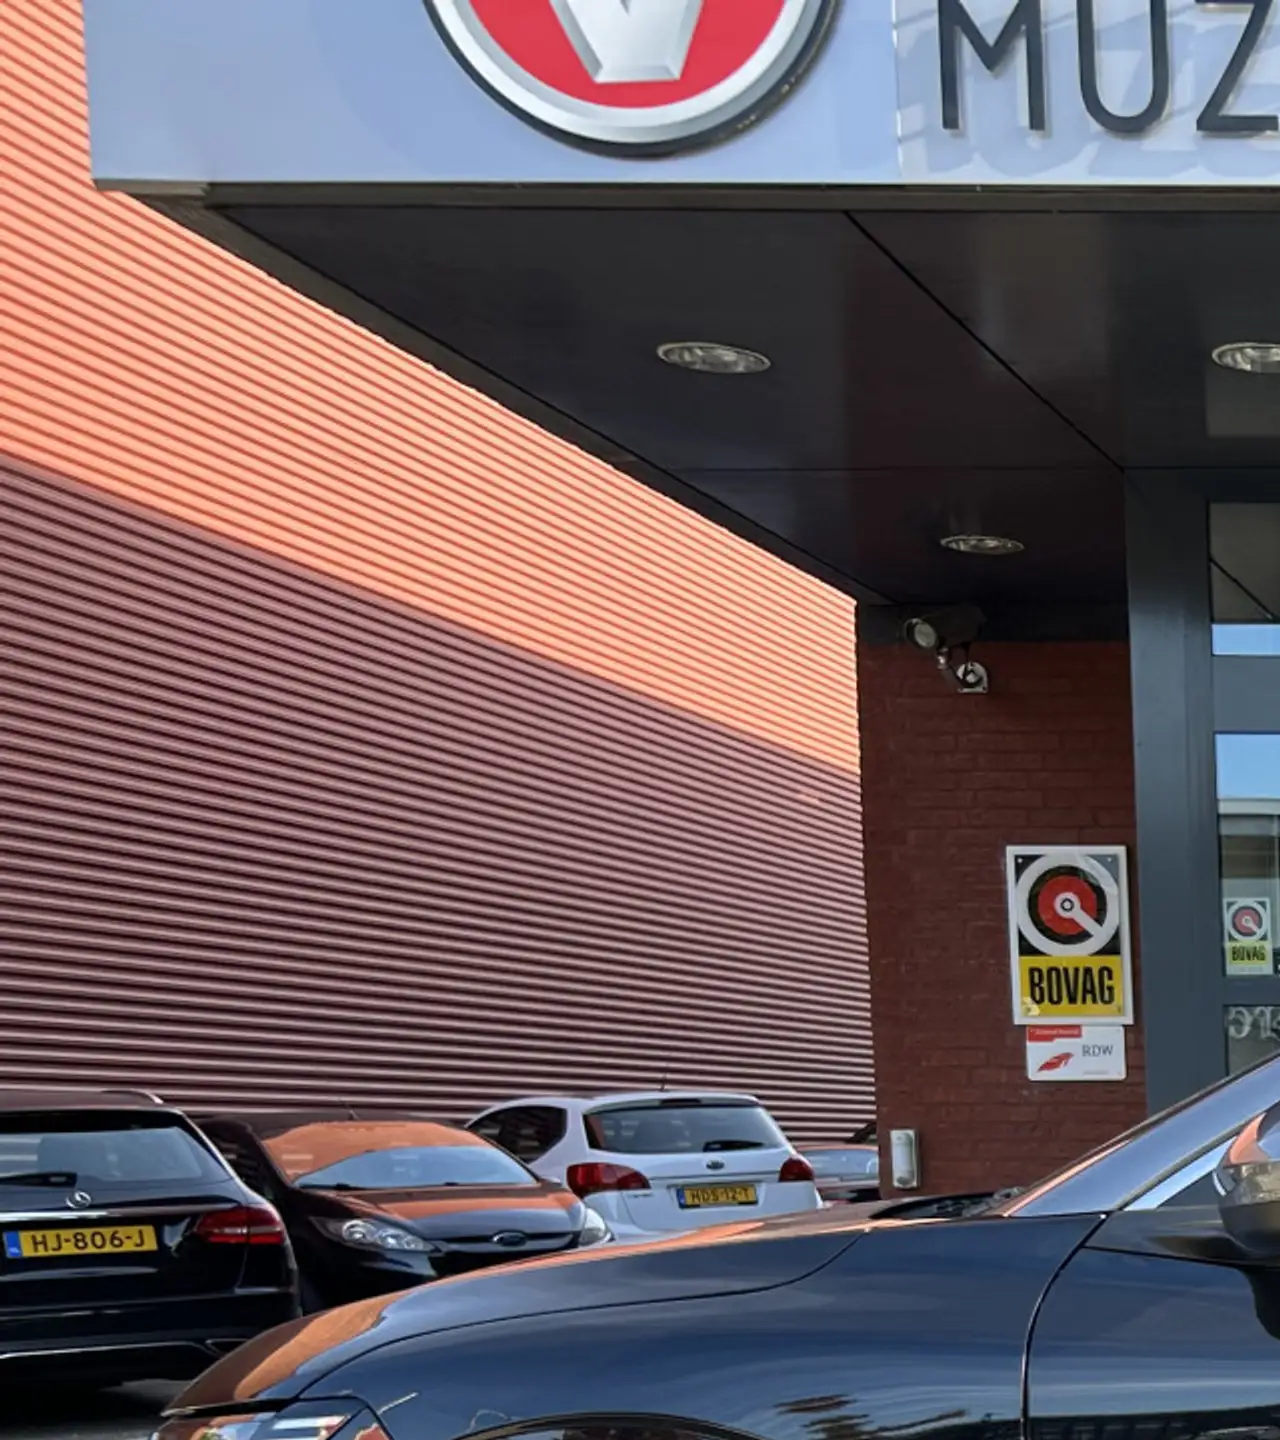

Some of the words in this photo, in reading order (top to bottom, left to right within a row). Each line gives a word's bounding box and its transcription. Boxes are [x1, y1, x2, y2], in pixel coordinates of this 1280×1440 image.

[1231, 946, 1267, 962] BOVAG
[1027, 965, 1116, 1006] BOVAG
[1081, 1043, 1115, 1057] RDW
[30, 1229, 146, 1253] HJ-806-J
